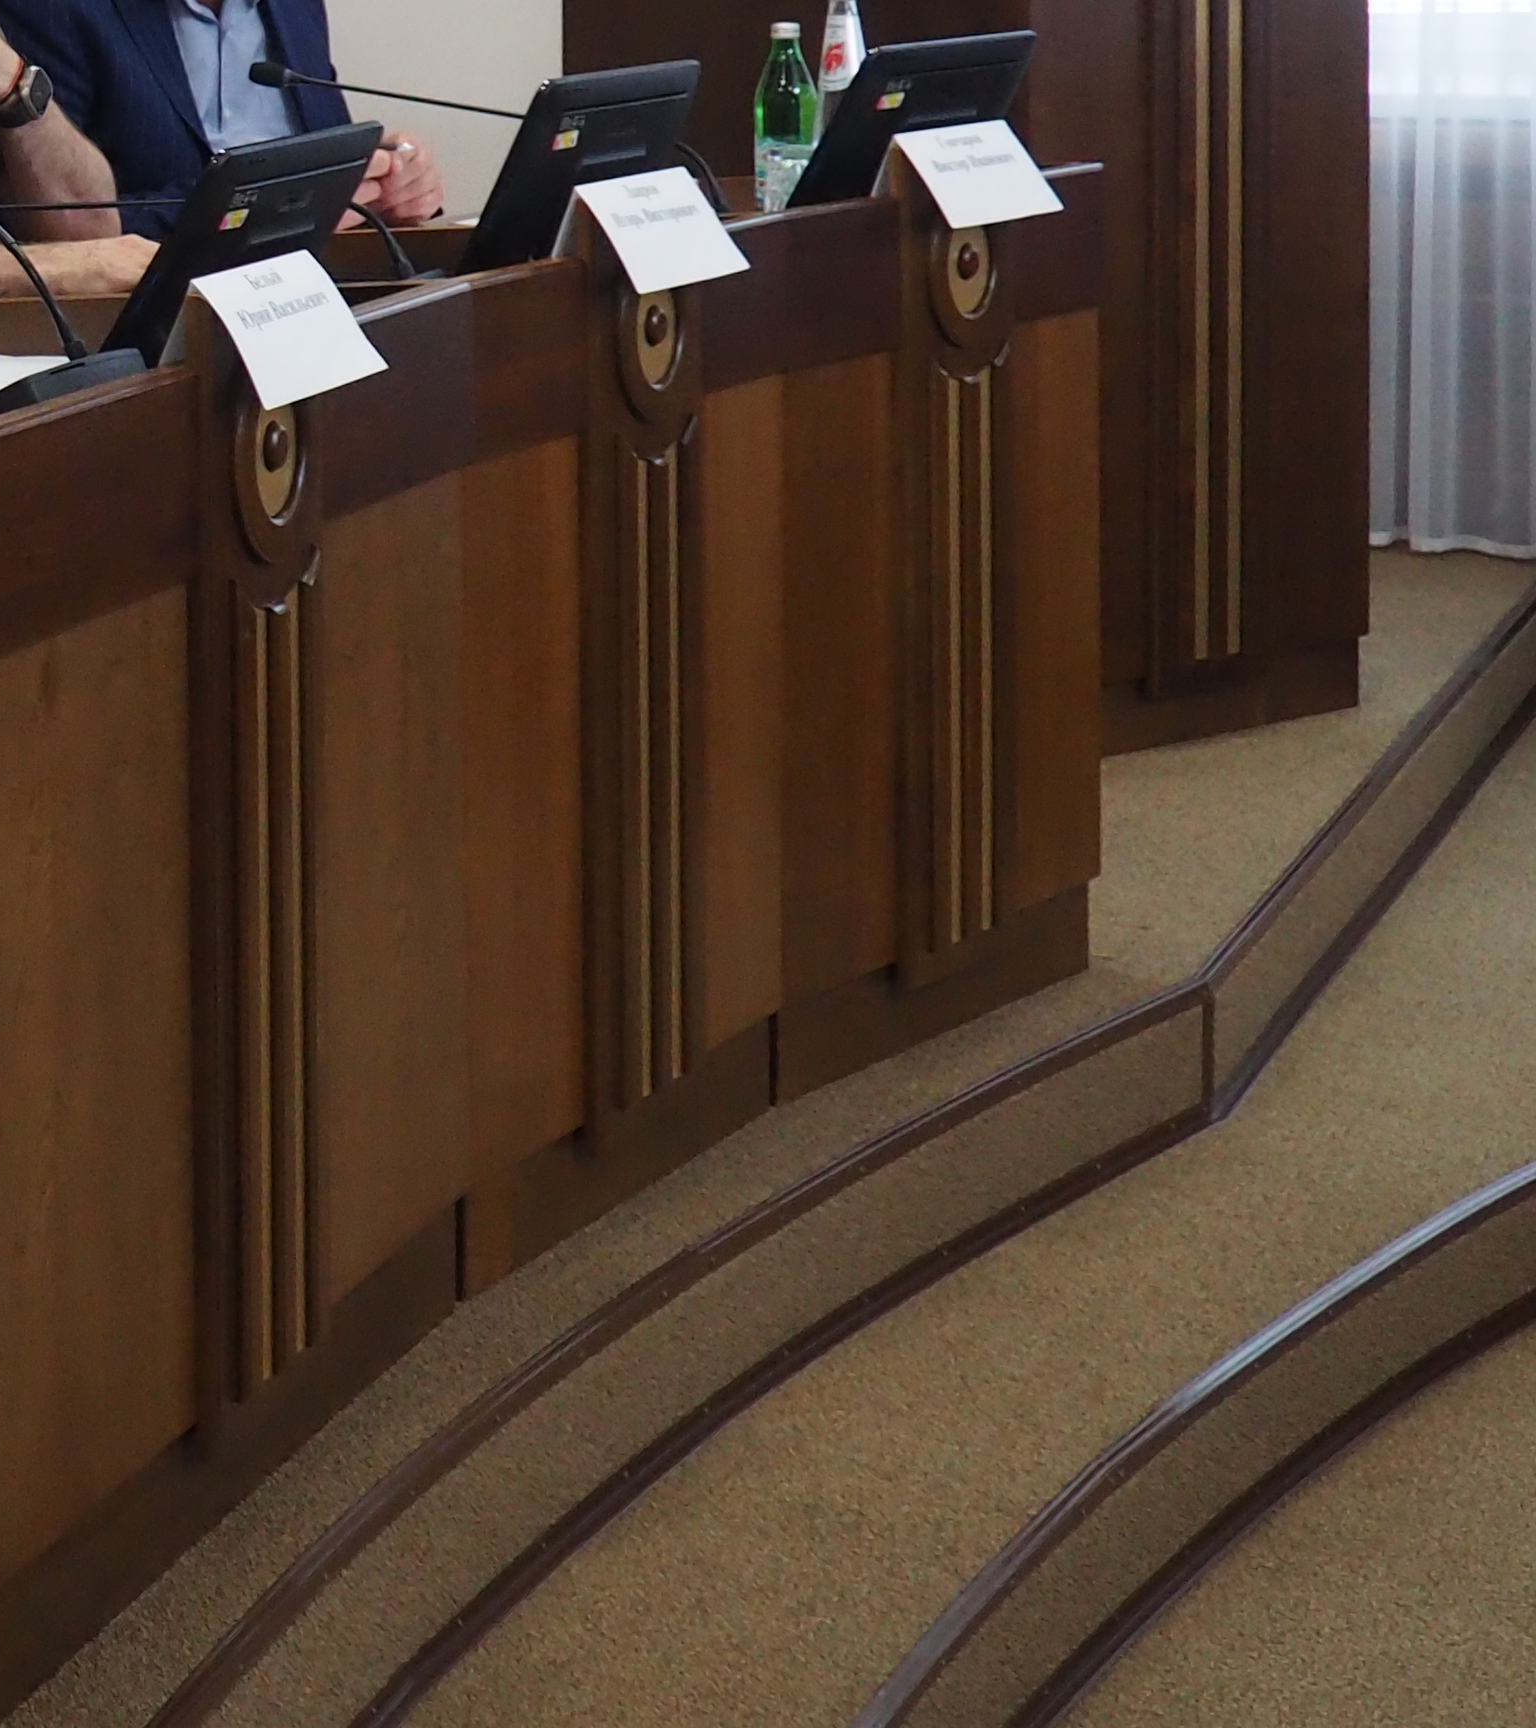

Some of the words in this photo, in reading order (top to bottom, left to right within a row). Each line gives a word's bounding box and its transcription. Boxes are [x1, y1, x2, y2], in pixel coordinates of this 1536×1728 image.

[244, 268, 283, 290] Белый
[237, 305, 273, 331] Юрий
[268, 292, 329, 319] Васильевич
